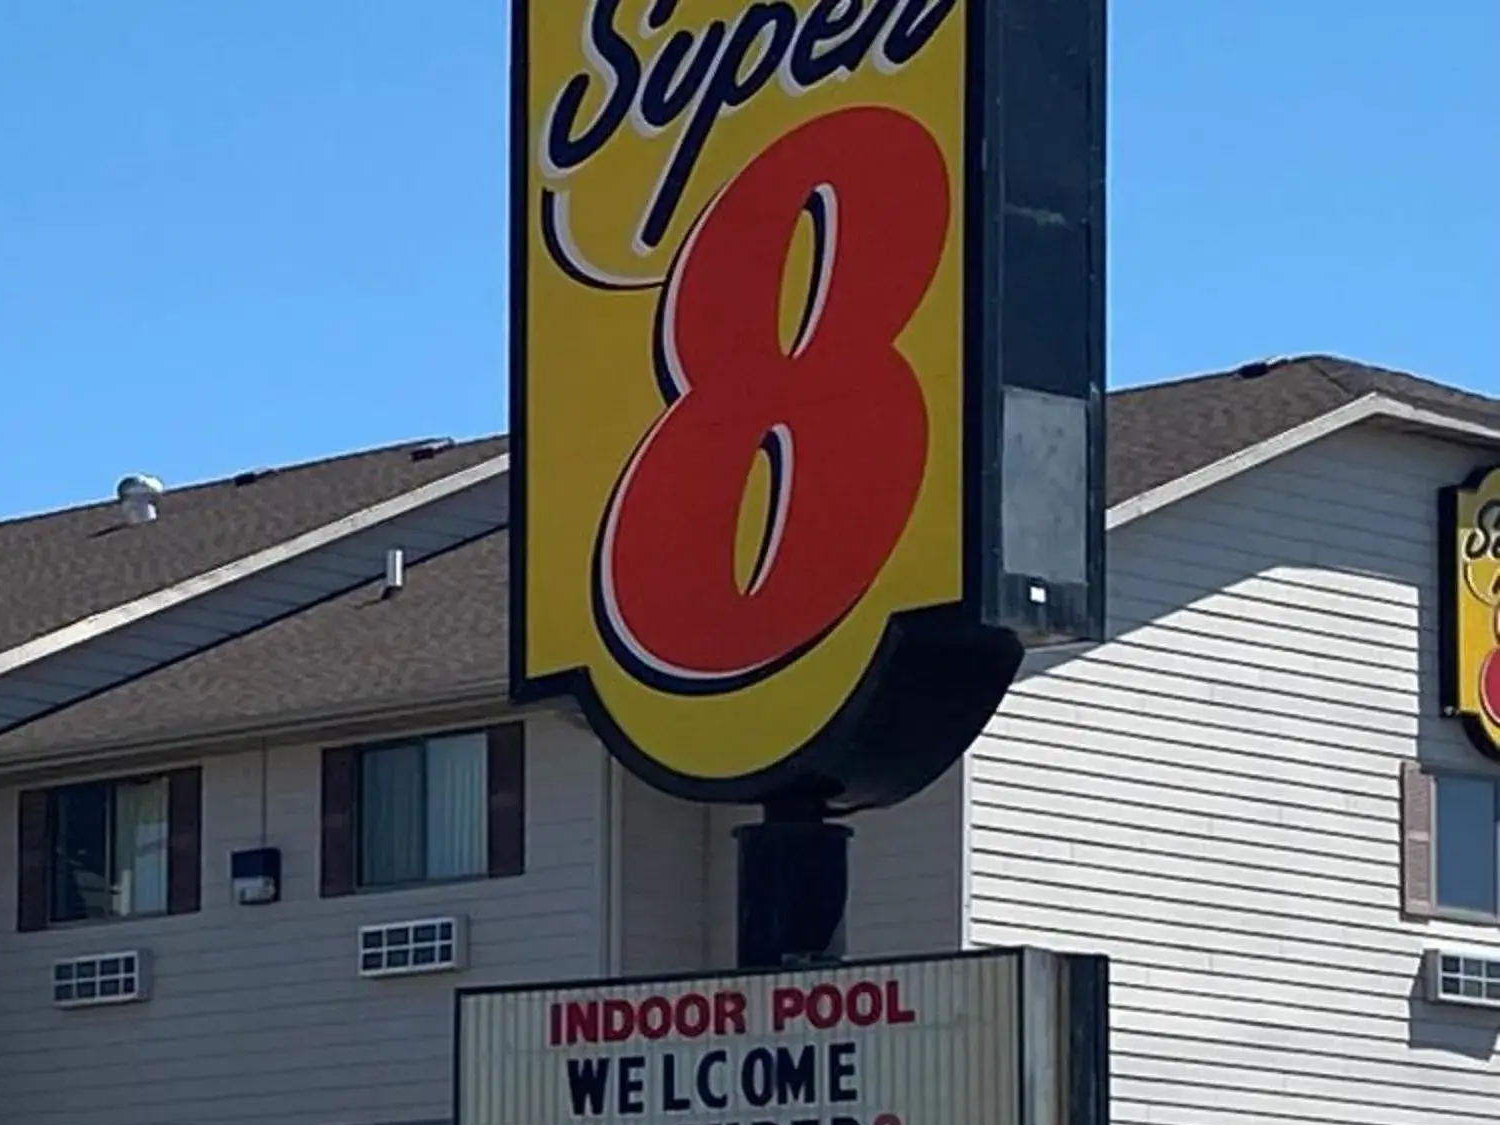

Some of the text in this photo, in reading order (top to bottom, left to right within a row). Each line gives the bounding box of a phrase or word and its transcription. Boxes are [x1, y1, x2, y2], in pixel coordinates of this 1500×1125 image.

[591, 105, 951, 696] 8
[550, 979, 916, 1047] INDOOR POOL
[566, 1041, 858, 1116] WELCOME
